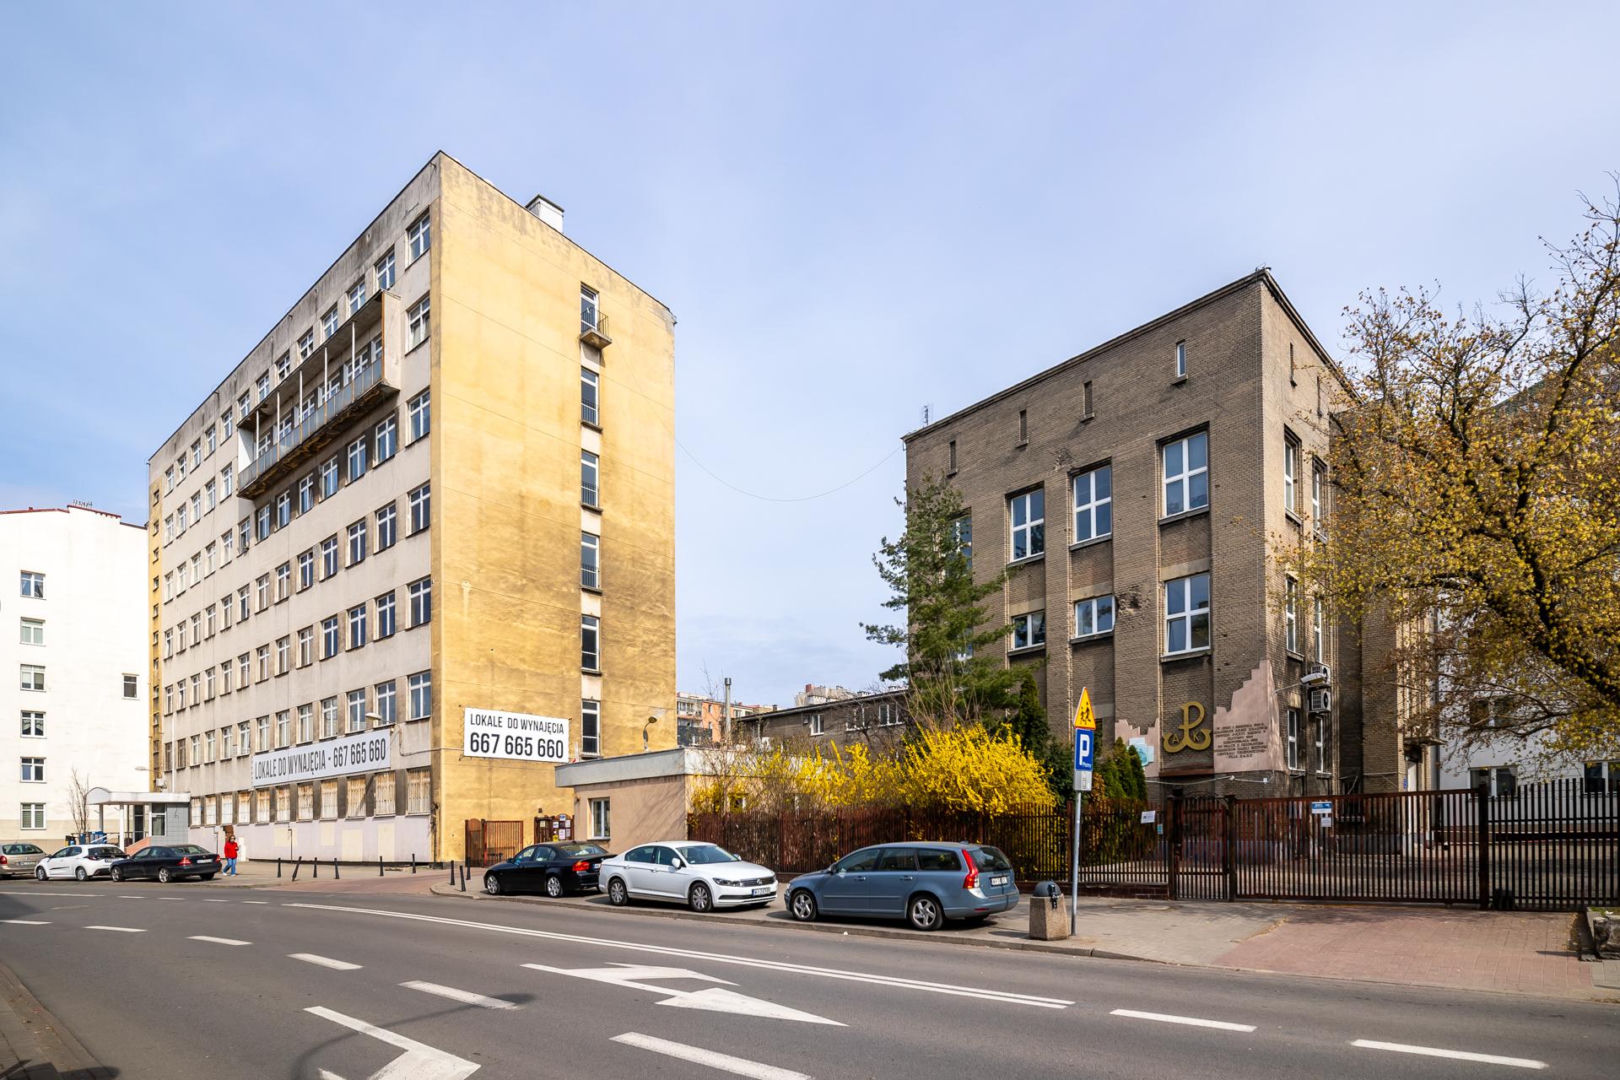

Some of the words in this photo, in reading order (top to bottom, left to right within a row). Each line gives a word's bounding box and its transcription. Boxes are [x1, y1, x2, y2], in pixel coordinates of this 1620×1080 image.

[470, 713, 503, 728] LOKALE
[507, 717, 518, 730] DO
[520, 719, 564, 735] WYNAJĘCIA
[255, 759, 277, 780] LOKALE
[278, 757, 287, 776] DO
[288, 750, 326, 775] WYNAJĘCIA
[333, 745, 348, 768] 667
[350, 742, 367, 765] 665
[369, 738, 387, 762] 660
[470, 732, 500, 754] 667
[505, 735, 533, 757] 665
[537, 738, 564, 759] 660
[1079, 733, 1090, 766] P
